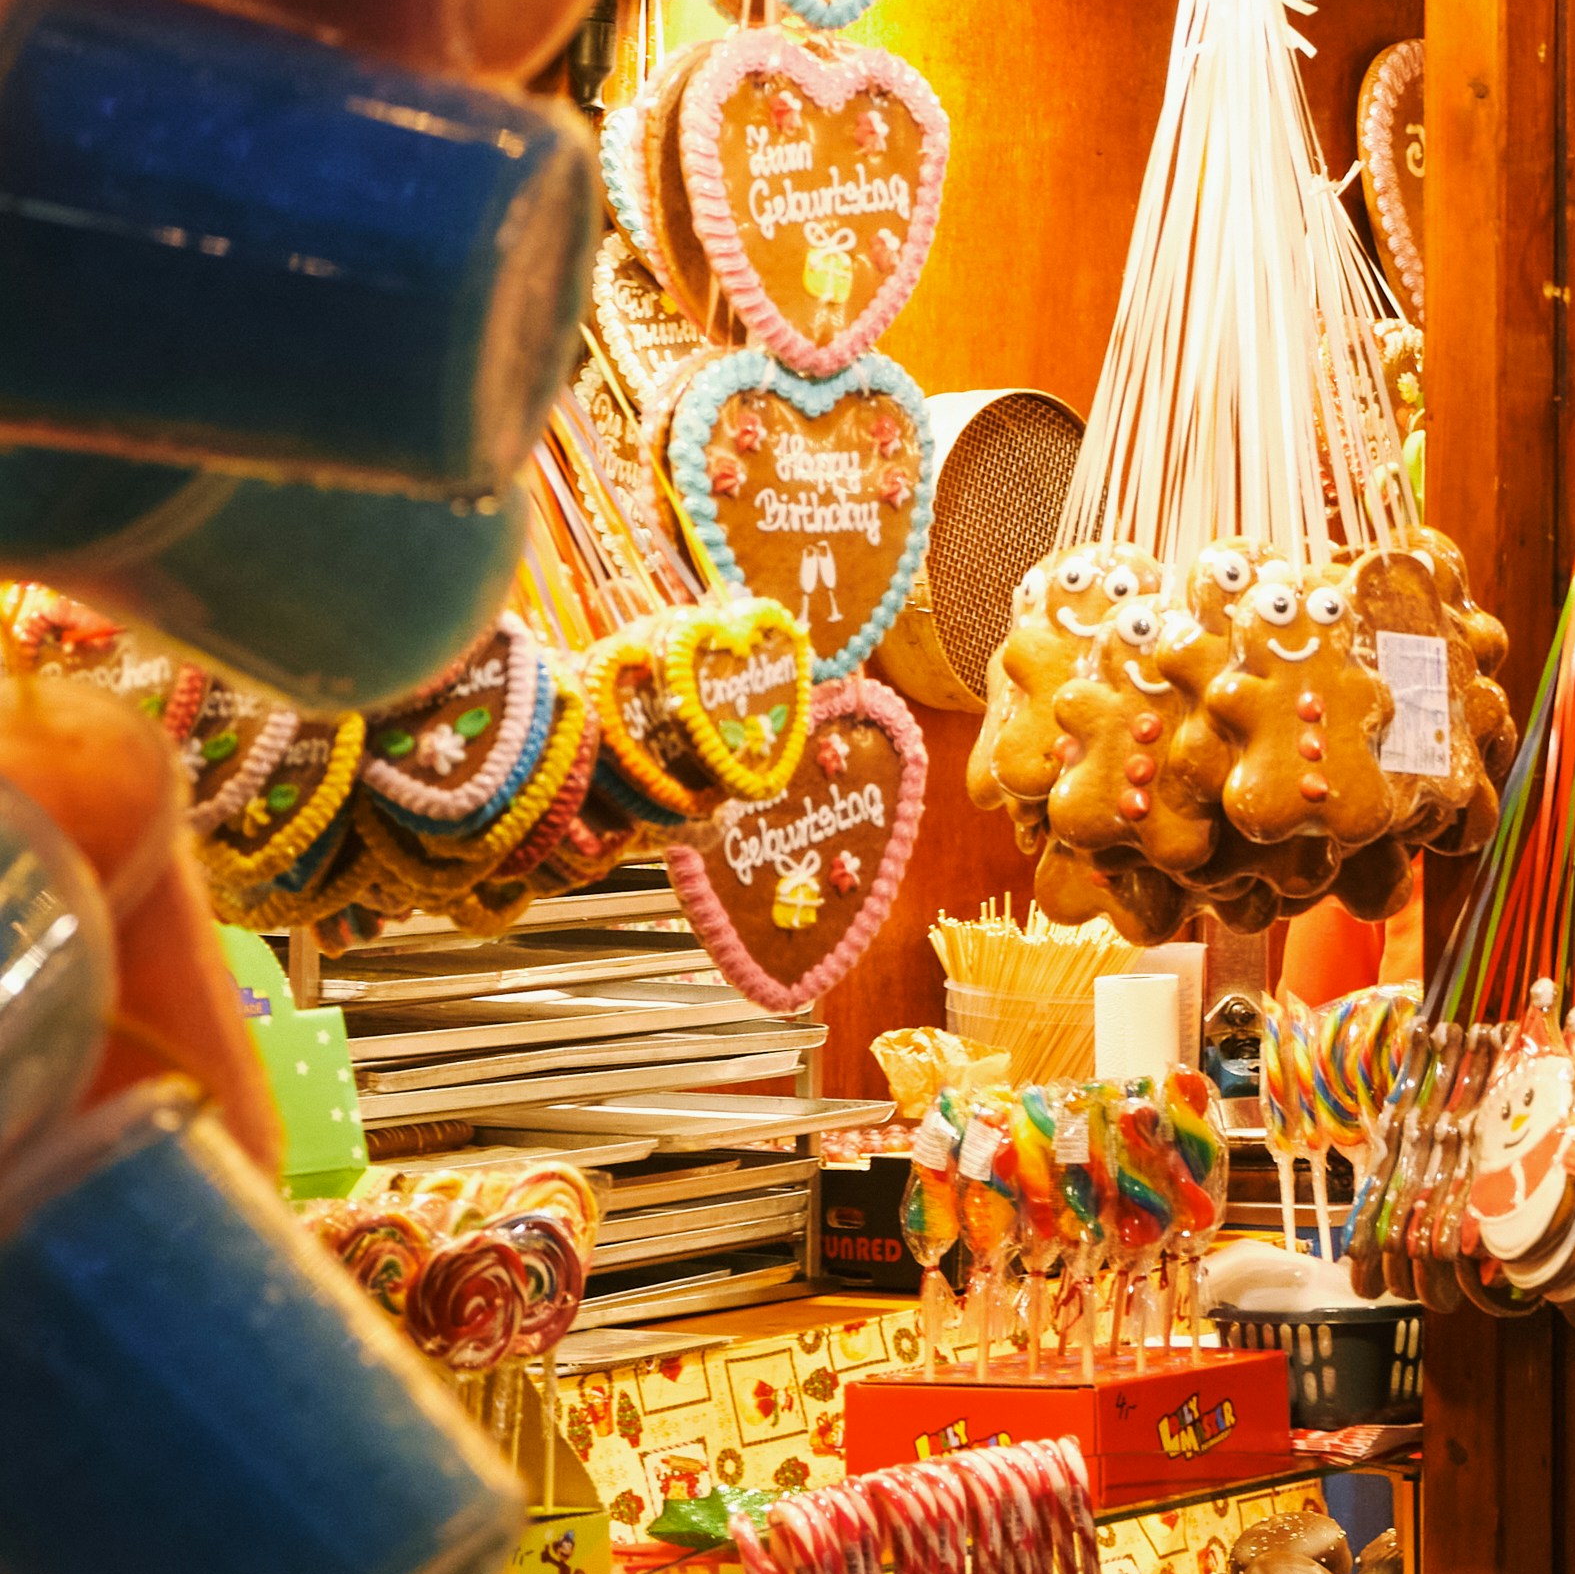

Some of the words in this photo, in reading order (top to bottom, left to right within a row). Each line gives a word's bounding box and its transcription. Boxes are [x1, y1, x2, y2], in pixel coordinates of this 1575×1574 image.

[746, 125, 814, 177] Zum
[748, 164, 911, 240] Geburtstag
[775, 433, 862, 494] Happy
[754, 487, 881, 547] Birthday
[698, 652, 797, 717] Engelchen
[724, 783, 886, 886] Geburtstag
